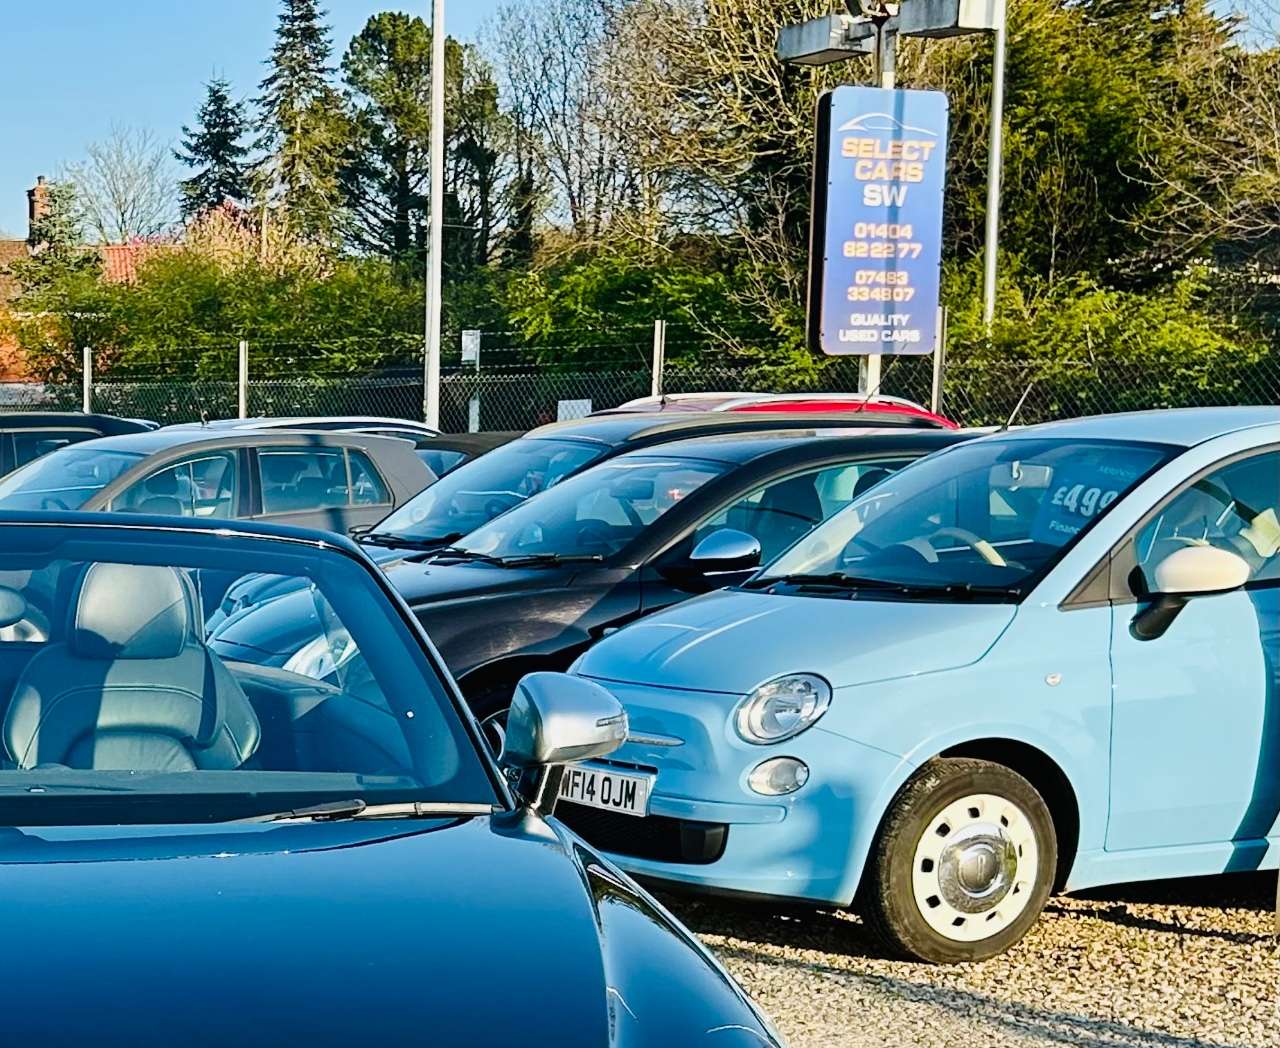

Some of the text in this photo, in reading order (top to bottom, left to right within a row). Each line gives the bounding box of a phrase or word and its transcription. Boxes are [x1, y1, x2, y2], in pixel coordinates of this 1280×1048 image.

[841, 137, 936, 161] SELECT
[855, 160, 923, 182] CARS
[863, 184, 908, 207] SW
[854, 222, 912, 239] 01404
[850, 313, 910, 326] QUALITY
[839, 329, 920, 342] USED CARS
[601, 777, 637, 809] OJM
